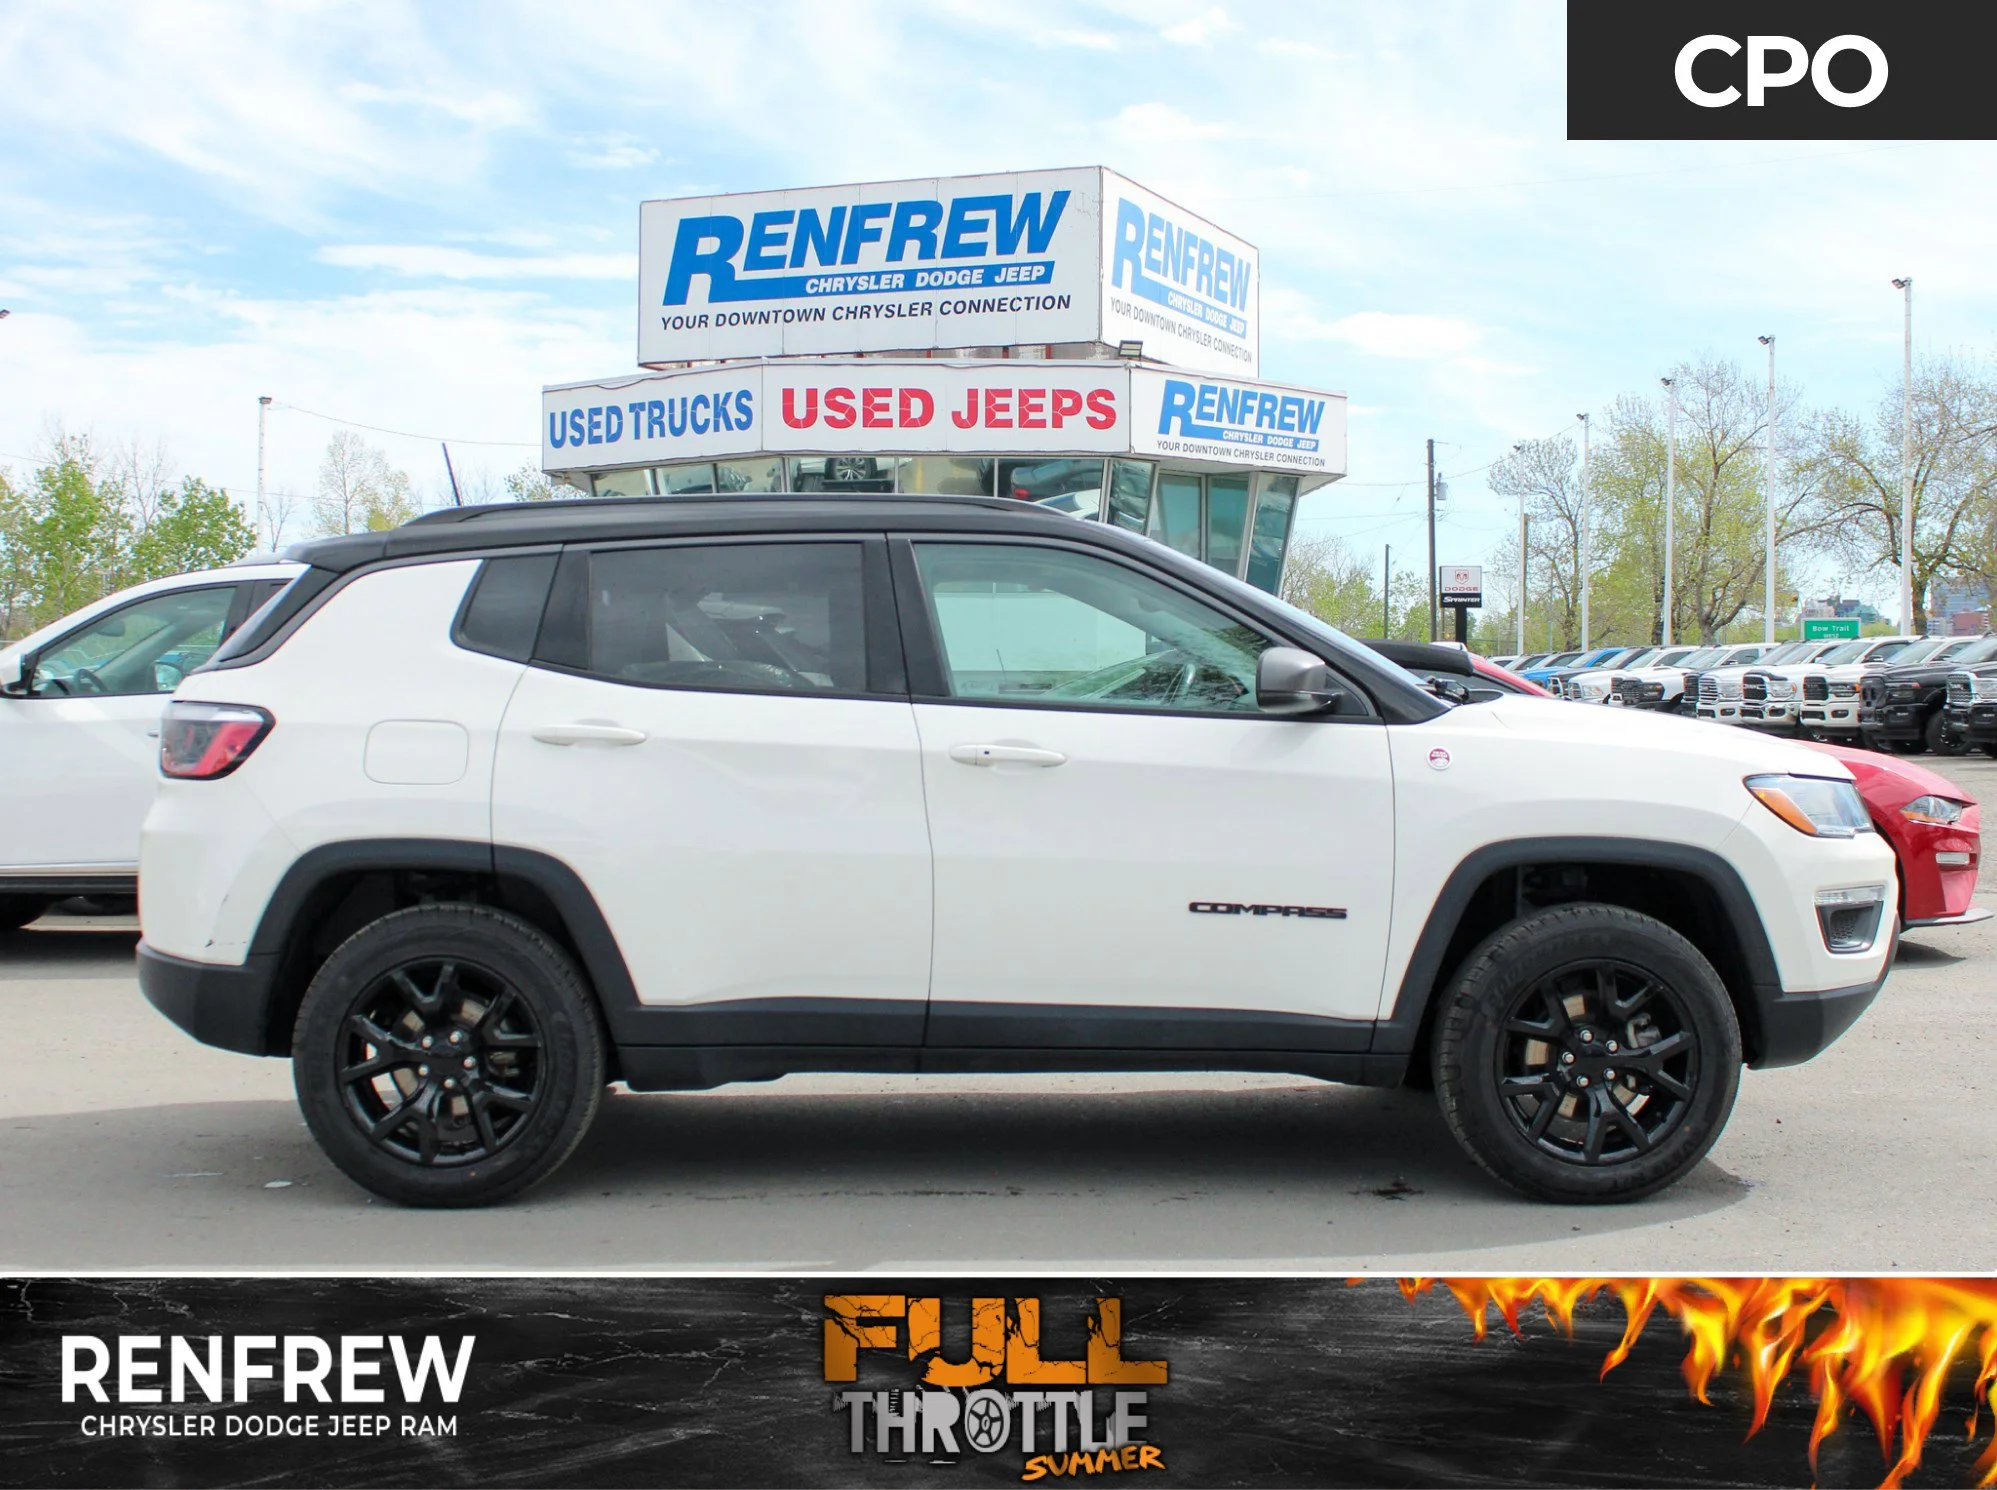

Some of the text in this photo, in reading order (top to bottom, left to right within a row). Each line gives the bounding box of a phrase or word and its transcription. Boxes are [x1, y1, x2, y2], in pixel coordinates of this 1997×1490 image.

[663, 190, 1071, 305] RENFREW
[1111, 196, 1251, 312] RENFREW
[805, 266, 1046, 294] CHRYSLER DODGE JEEP
[661, 294, 1071, 331] YOUR DOWNTOWN CHRYSLER CONNECTION
[1111, 297, 1252, 364] YOUR DOWNTOWN CHRYSLER CONNECTION
[1167, 291, 1246, 334] CHRYSLER DODGE JEEP
[549, 388, 754, 449] USED TRUCKS
[782, 387, 1116, 430] USED JEEPS
[1158, 379, 1326, 436] RENFREW
[1157, 440, 1326, 467] YOUR DOWNTOWN CHRYSLER CONNECTION
[1222, 429, 1317, 449] CHRYSLER DODGE JEEP
[1188, 902, 1348, 920] COMPASS
